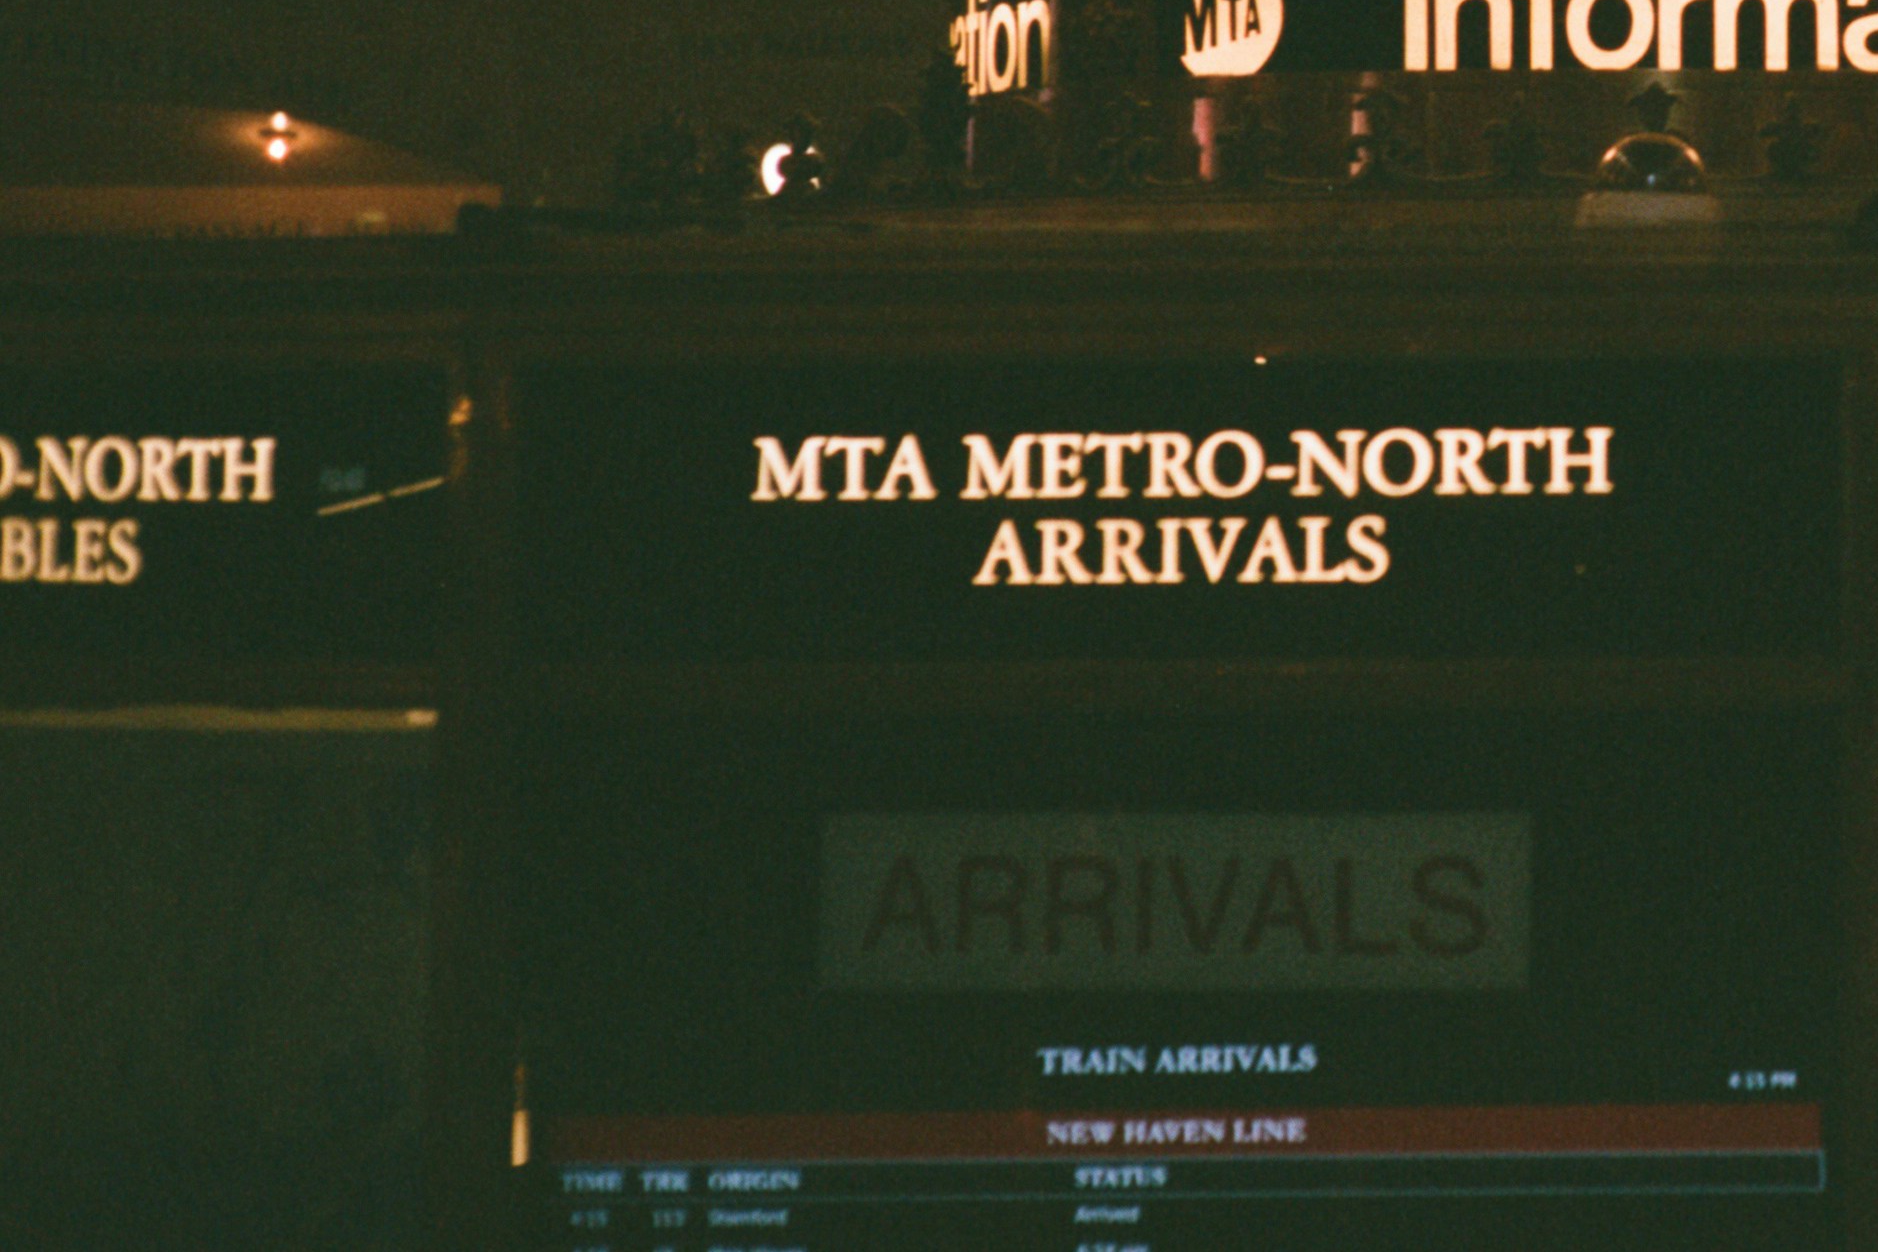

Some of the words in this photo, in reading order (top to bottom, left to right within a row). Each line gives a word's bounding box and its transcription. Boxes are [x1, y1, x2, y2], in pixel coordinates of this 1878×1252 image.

[750, 433, 938, 502] MTA
[958, 425, 1615, 501] METRO-NORTH
[971, 514, 1392, 586] ARRIVALS
[860, 853, 1491, 958] ARRIVALS
[1037, 1046, 1147, 1075] TRAIN
[1154, 1044, 1319, 1074] ARRIVALS
[1046, 1119, 1116, 1145] NEW
[1122, 1118, 1226, 1144] HAVEN
[1231, 1117, 1307, 1143] LINE
[1073, 1164, 1168, 1188] STATUS
